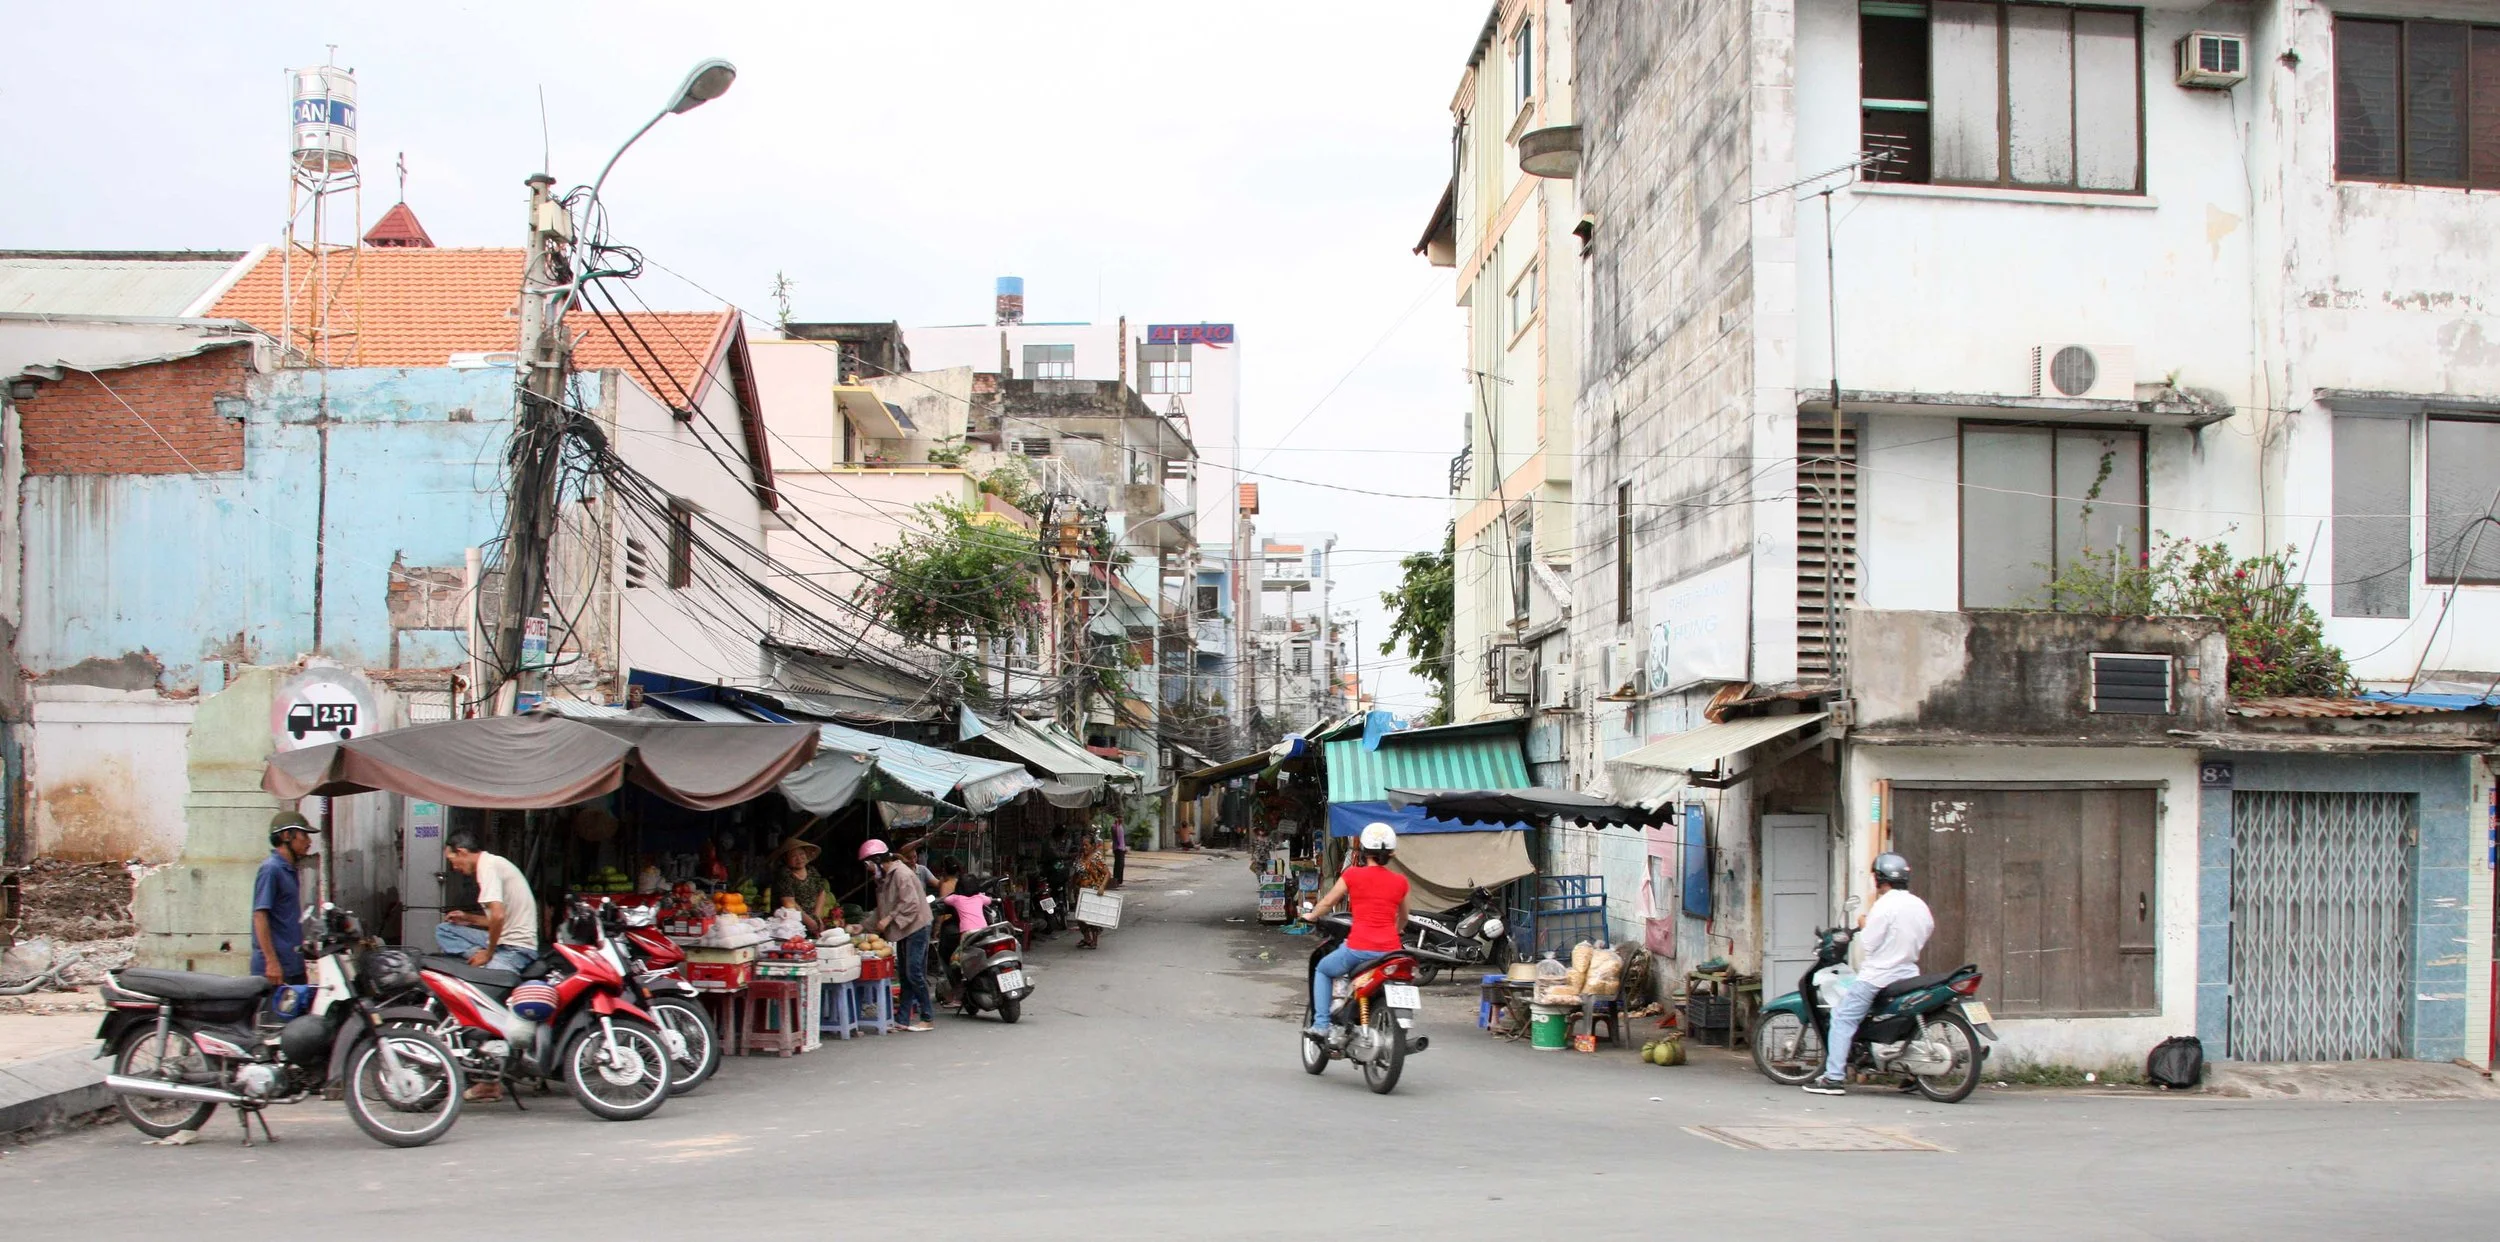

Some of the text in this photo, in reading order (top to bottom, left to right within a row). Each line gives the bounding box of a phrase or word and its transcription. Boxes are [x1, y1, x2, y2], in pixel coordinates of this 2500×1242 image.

[525, 619, 547, 637] HOTEL
[321, 706, 353, 723] 2.5T
[1418, 917, 1443, 930] REPSOL
